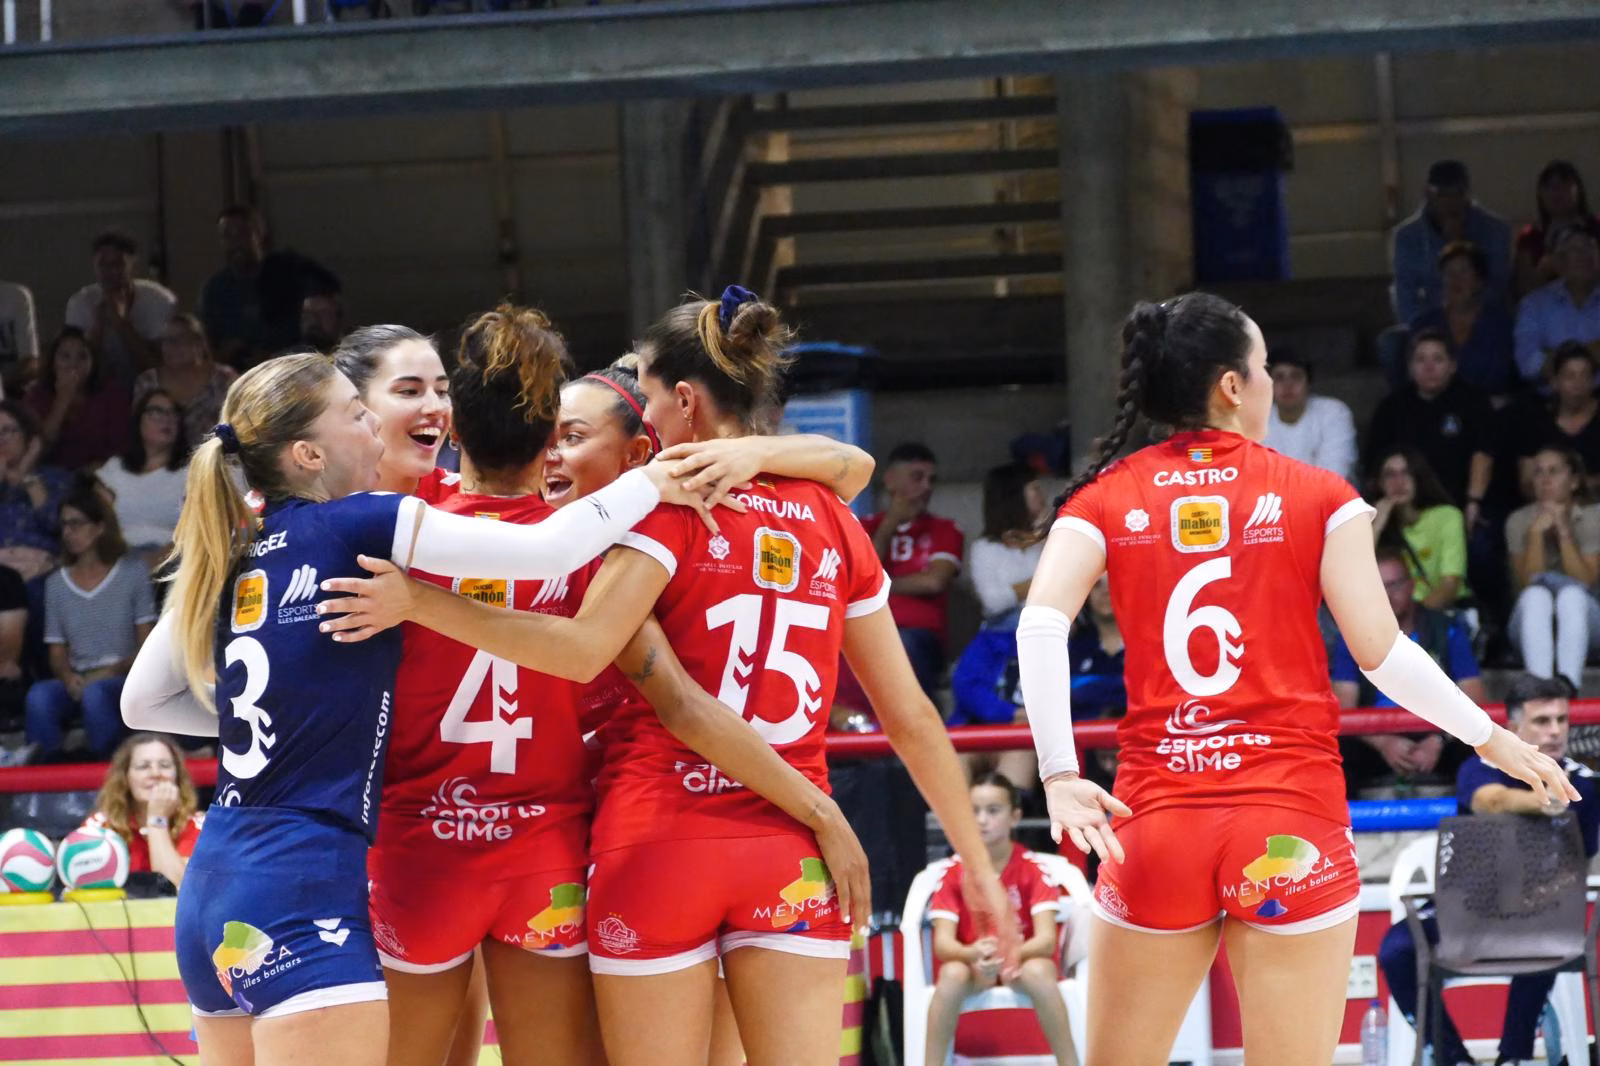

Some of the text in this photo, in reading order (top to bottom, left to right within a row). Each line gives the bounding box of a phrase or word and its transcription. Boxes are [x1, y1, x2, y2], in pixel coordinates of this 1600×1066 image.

[1153, 466, 1239, 486] CASTRO
[731, 492, 816, 522] ORTUNA
[1243, 527, 1284, 539] ESPORTS
[1259, 536, 1284, 544] BALEARS
[1162, 555, 1245, 697] 6
[706, 593, 831, 745] 15
[222, 635, 277, 780] 3
[440, 648, 533, 775] 4
[432, 818, 513, 842] CIMe
[1285, 883, 1307, 897] illes
[504, 921, 575, 944] MENO
[243, 957, 302, 990] illes balears
